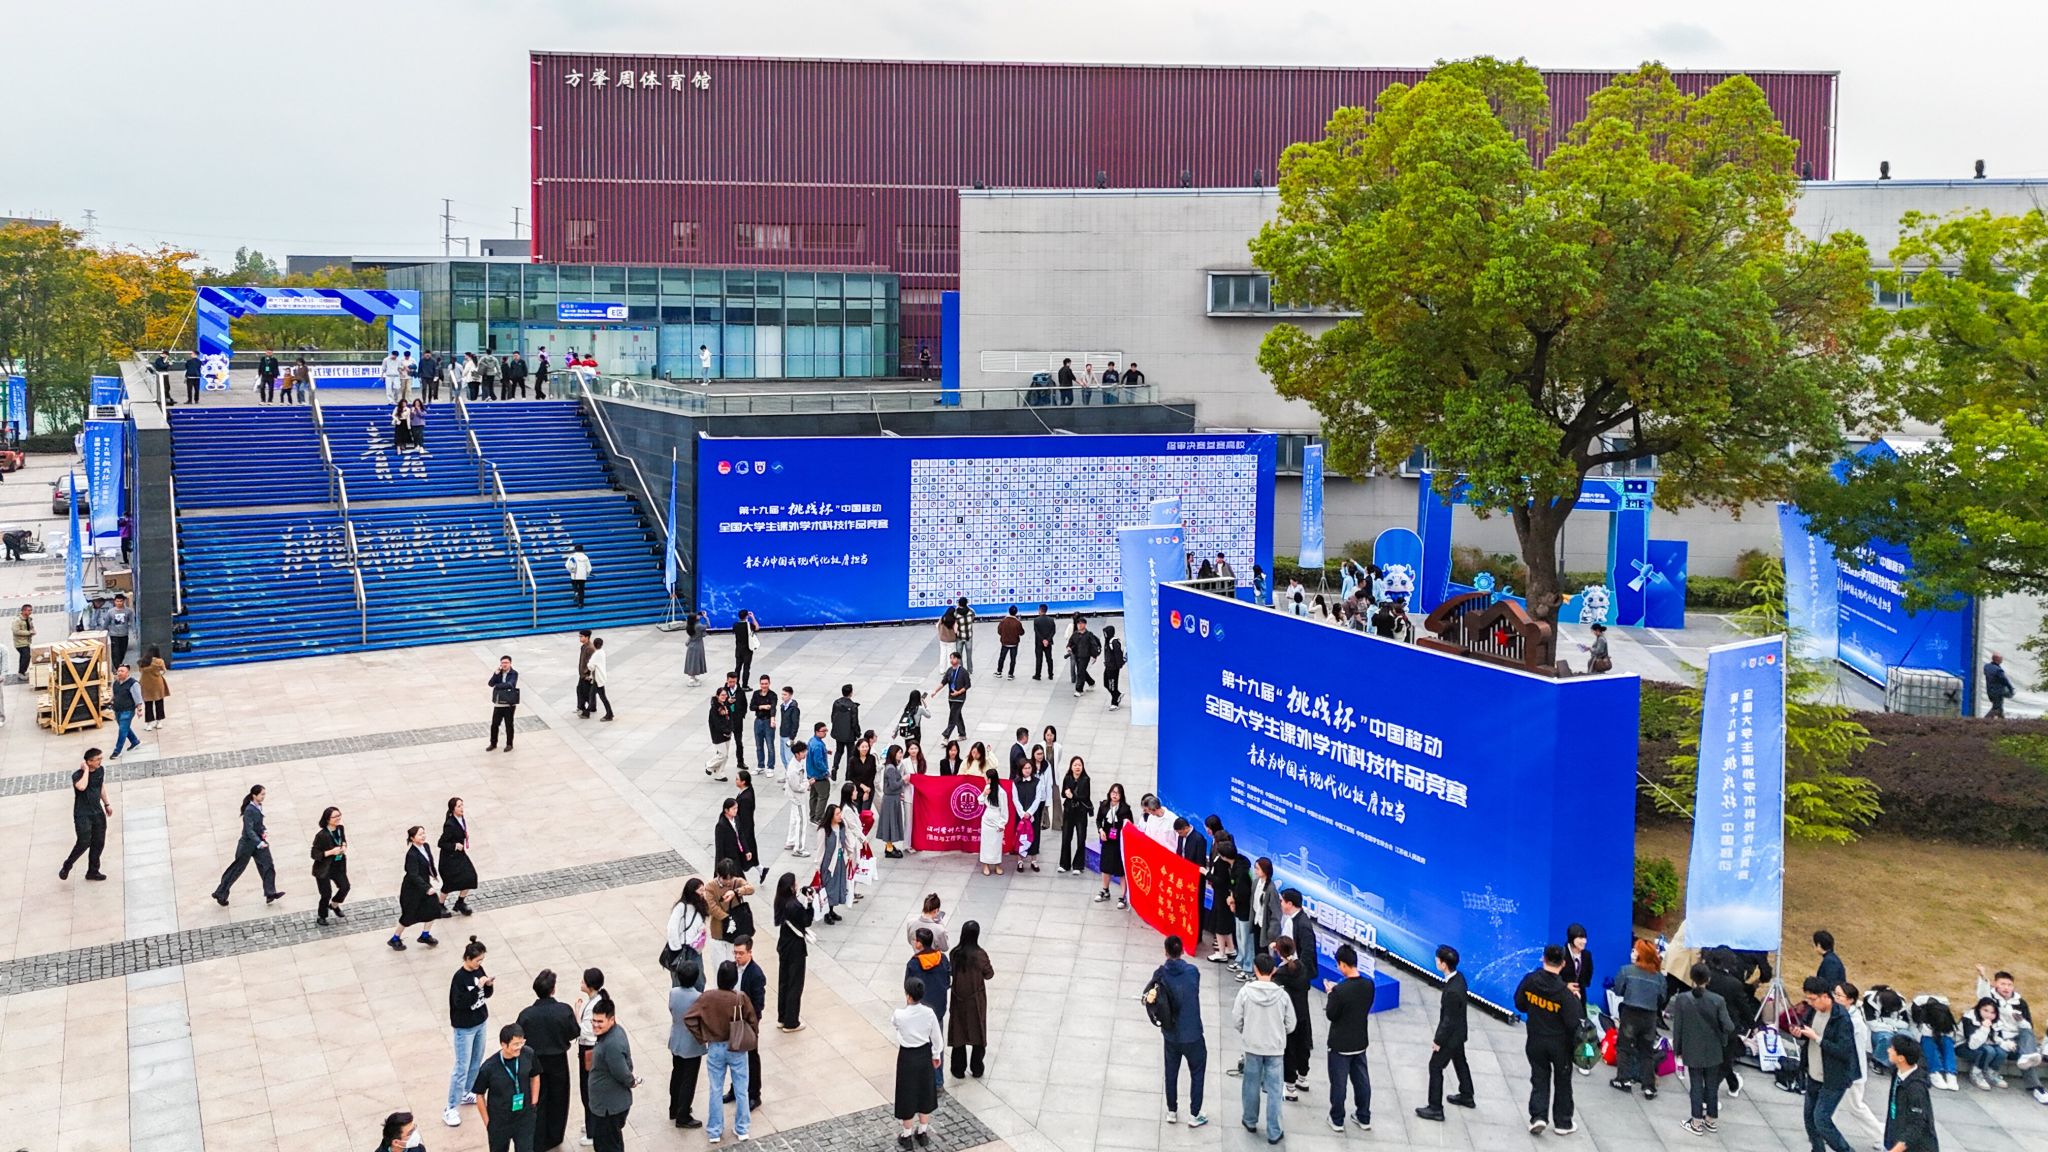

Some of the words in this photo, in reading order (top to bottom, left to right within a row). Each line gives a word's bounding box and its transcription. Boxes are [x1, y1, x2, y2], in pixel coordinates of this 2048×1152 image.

[564, 68, 712, 91] 方肇周体育馆
[1205, 693, 1468, 809] 全国大学生课外学术科技作品竞赛
[1222, 669, 1443, 759] 第十九届“挑战杯”中国移动
[1247, 742, 1407, 825] 青春为中国式现代化挺膺担当
[1525, 991, 1561, 1013] TRUST
